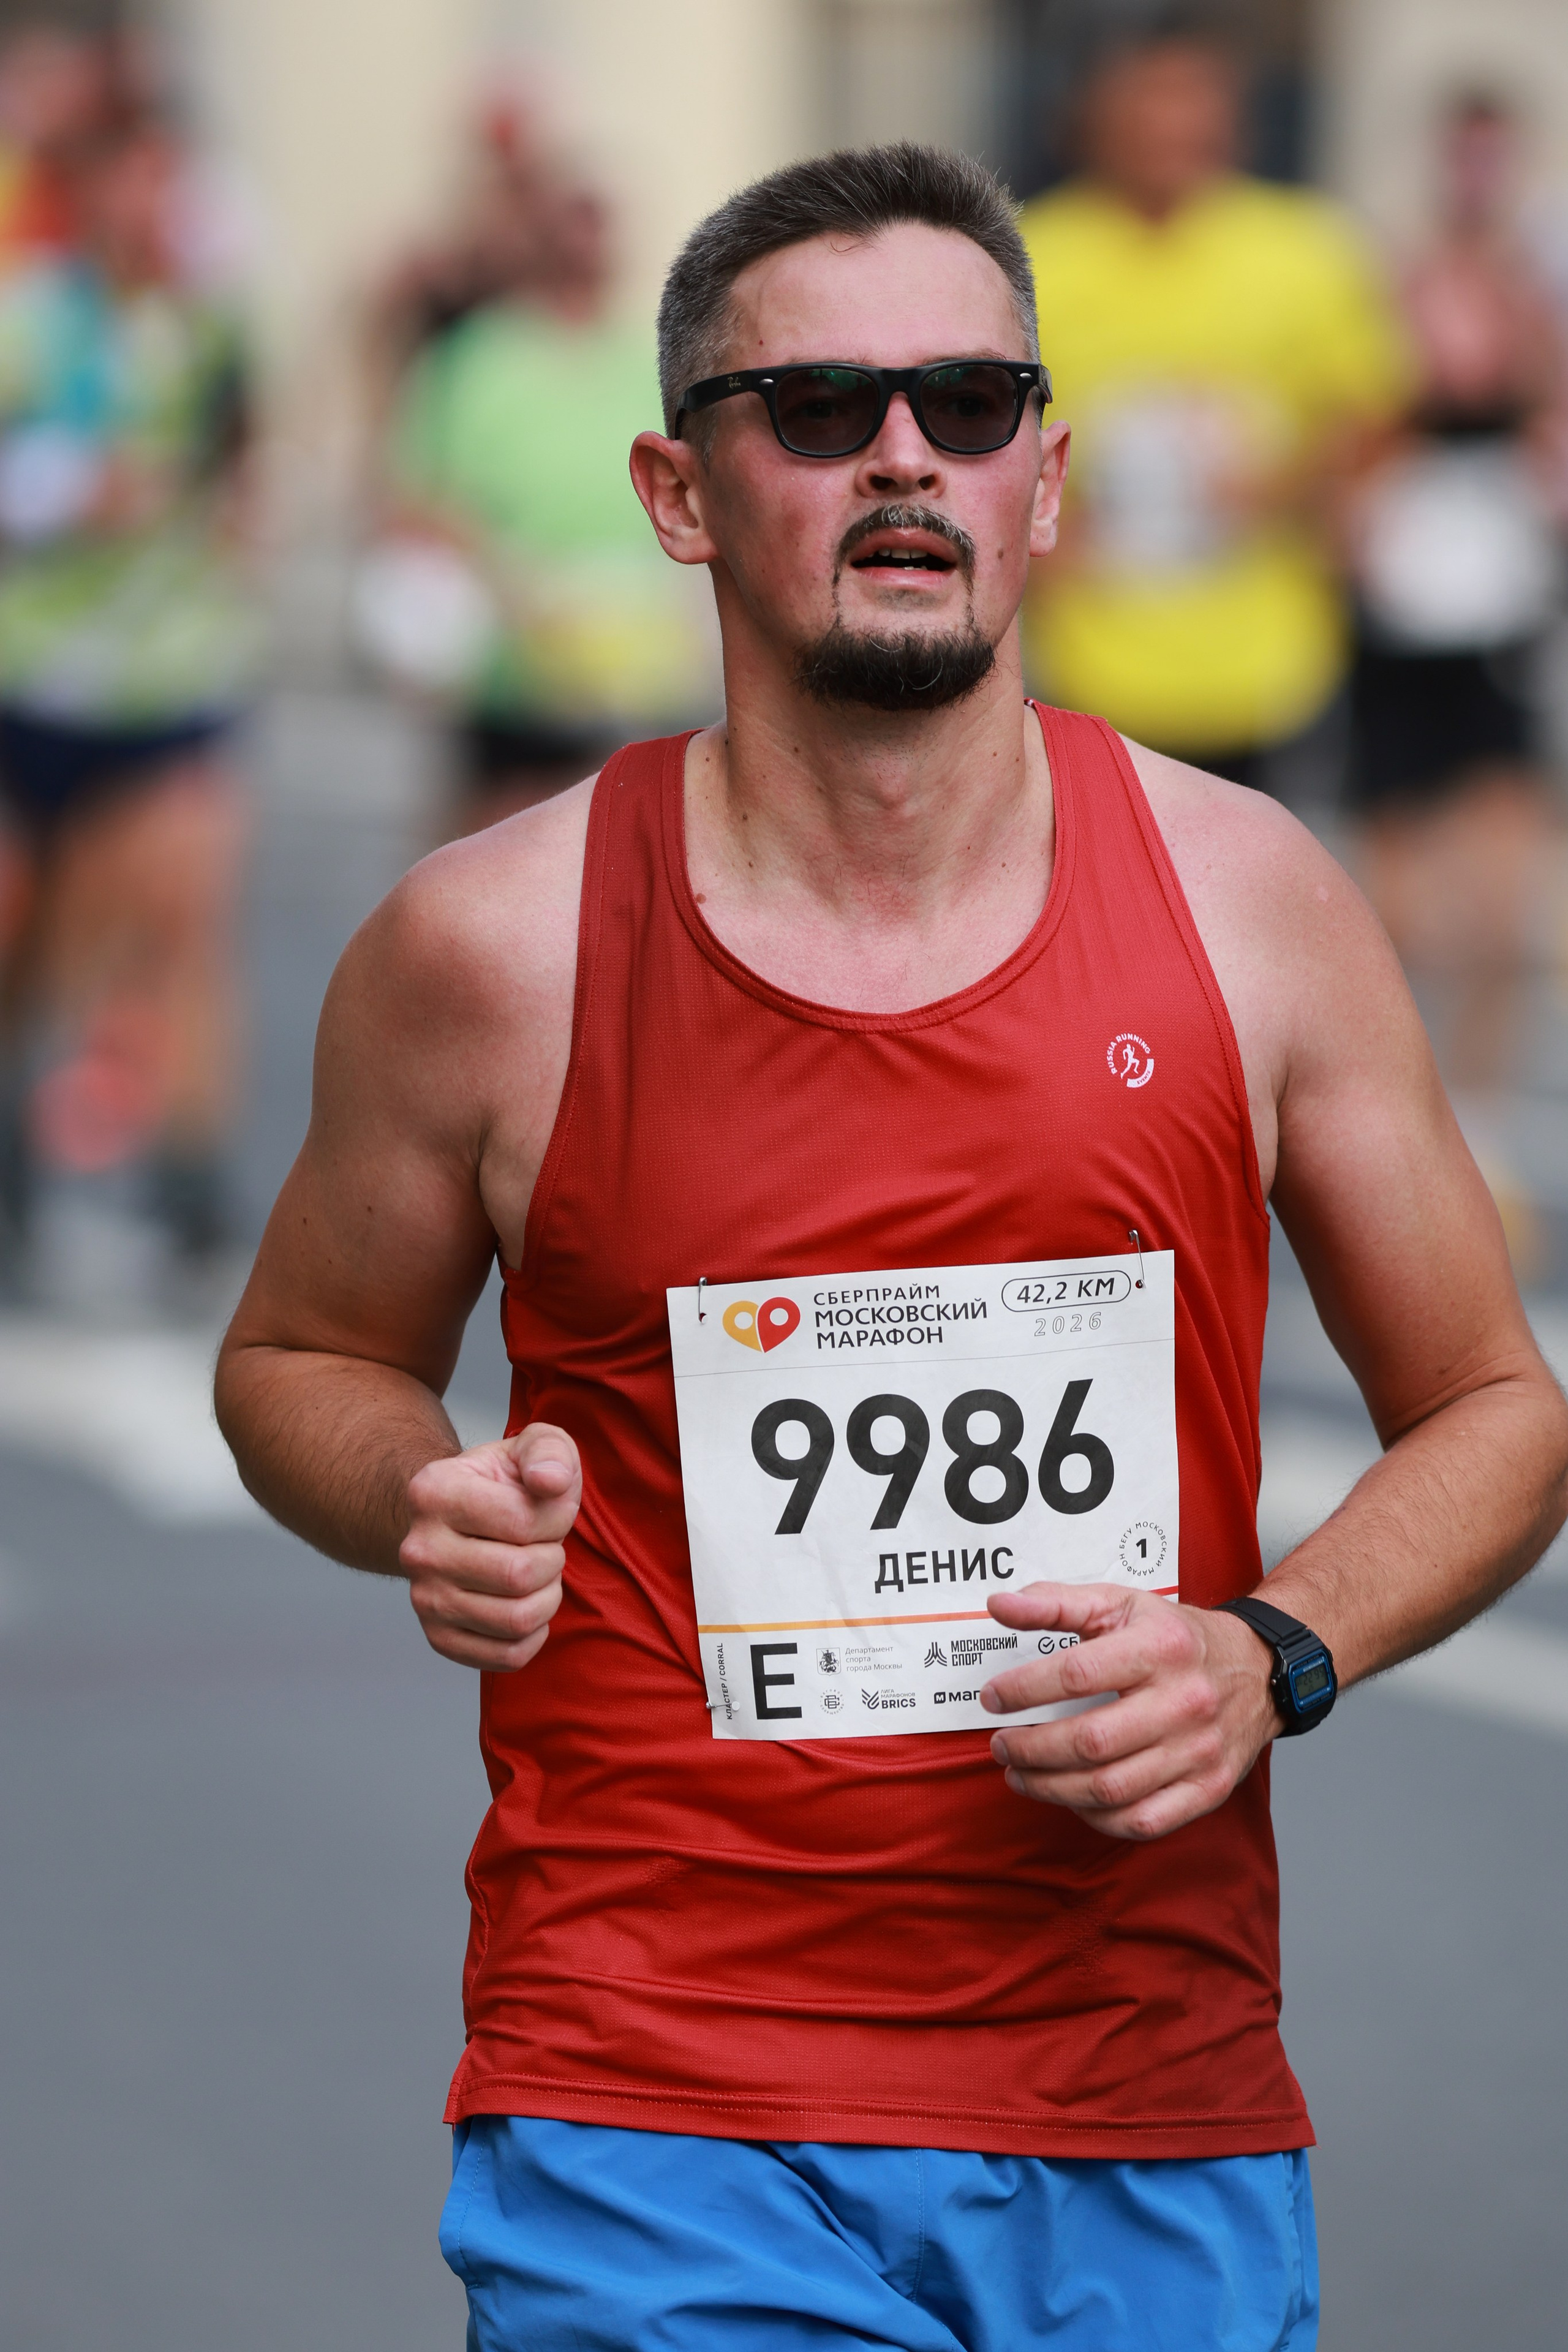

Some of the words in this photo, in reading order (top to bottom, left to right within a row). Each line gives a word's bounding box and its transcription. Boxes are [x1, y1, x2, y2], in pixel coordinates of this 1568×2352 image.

[1107, 1041, 1117, 1074] RUSSIA
[1115, 1033, 1151, 1054] RUNNING
[1137, 1070, 1151, 1085] EVENTS
[813, 1283, 940, 1306] СБЕРПРАЙМ
[1017, 1281, 1068, 1305] 42,2
[1077, 1277, 1115, 1298] КМ
[815, 1297, 988, 1328] МОСКОВСКИЙ
[1034, 1311, 1102, 1337] 2026
[816, 1326, 943, 1349] МАРАФОН
[751, 1378, 1115, 1535] 9986
[1119, 1528, 1132, 1549] БЕГУ
[1136, 1521, 1167, 1567] МОСКОВСКИЙ
[1136, 1538, 1147, 1558] 1
[874, 1547, 1015, 1594] ДЕНИС
[1119, 1553, 1155, 1577] МАРАФОН
[845, 1646, 894, 1656] Департамент
[951, 1634, 1018, 1653] МОСКОВСКИЙ
[1058, 1636, 1081, 1649] СБ
[717, 1643, 726, 1676] CORRAL
[951, 1653, 983, 1666] СПОРТ
[721, 1683, 733, 1720] КЛАСТЕР
[881, 1698, 916, 1709] BRICS
[949, 1691, 981, 1702] маг
